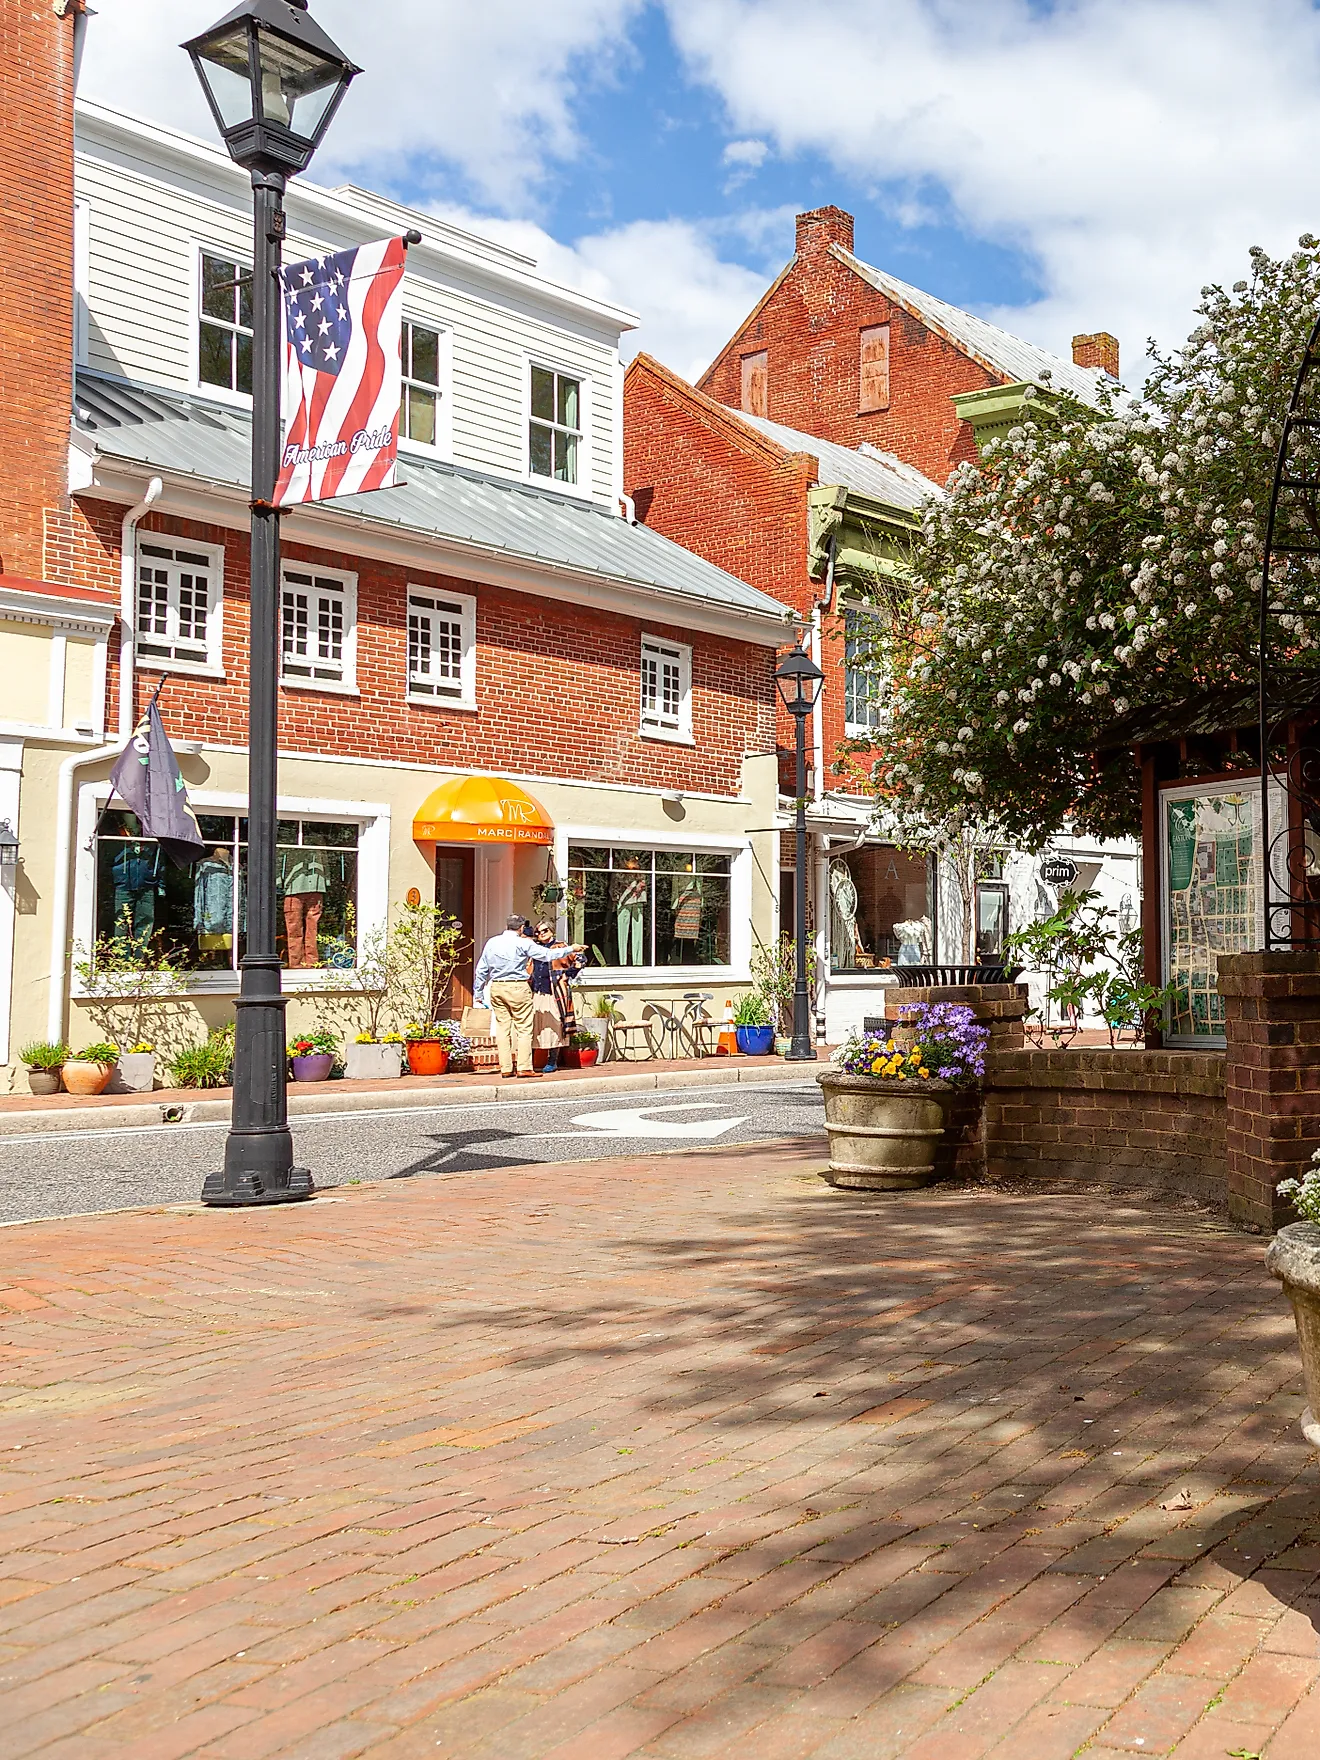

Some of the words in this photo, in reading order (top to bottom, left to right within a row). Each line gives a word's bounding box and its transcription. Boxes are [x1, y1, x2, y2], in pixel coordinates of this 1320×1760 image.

[283, 440, 347, 468] American
[349, 425, 393, 454] Pride
[1045, 865, 1070, 878] prim
